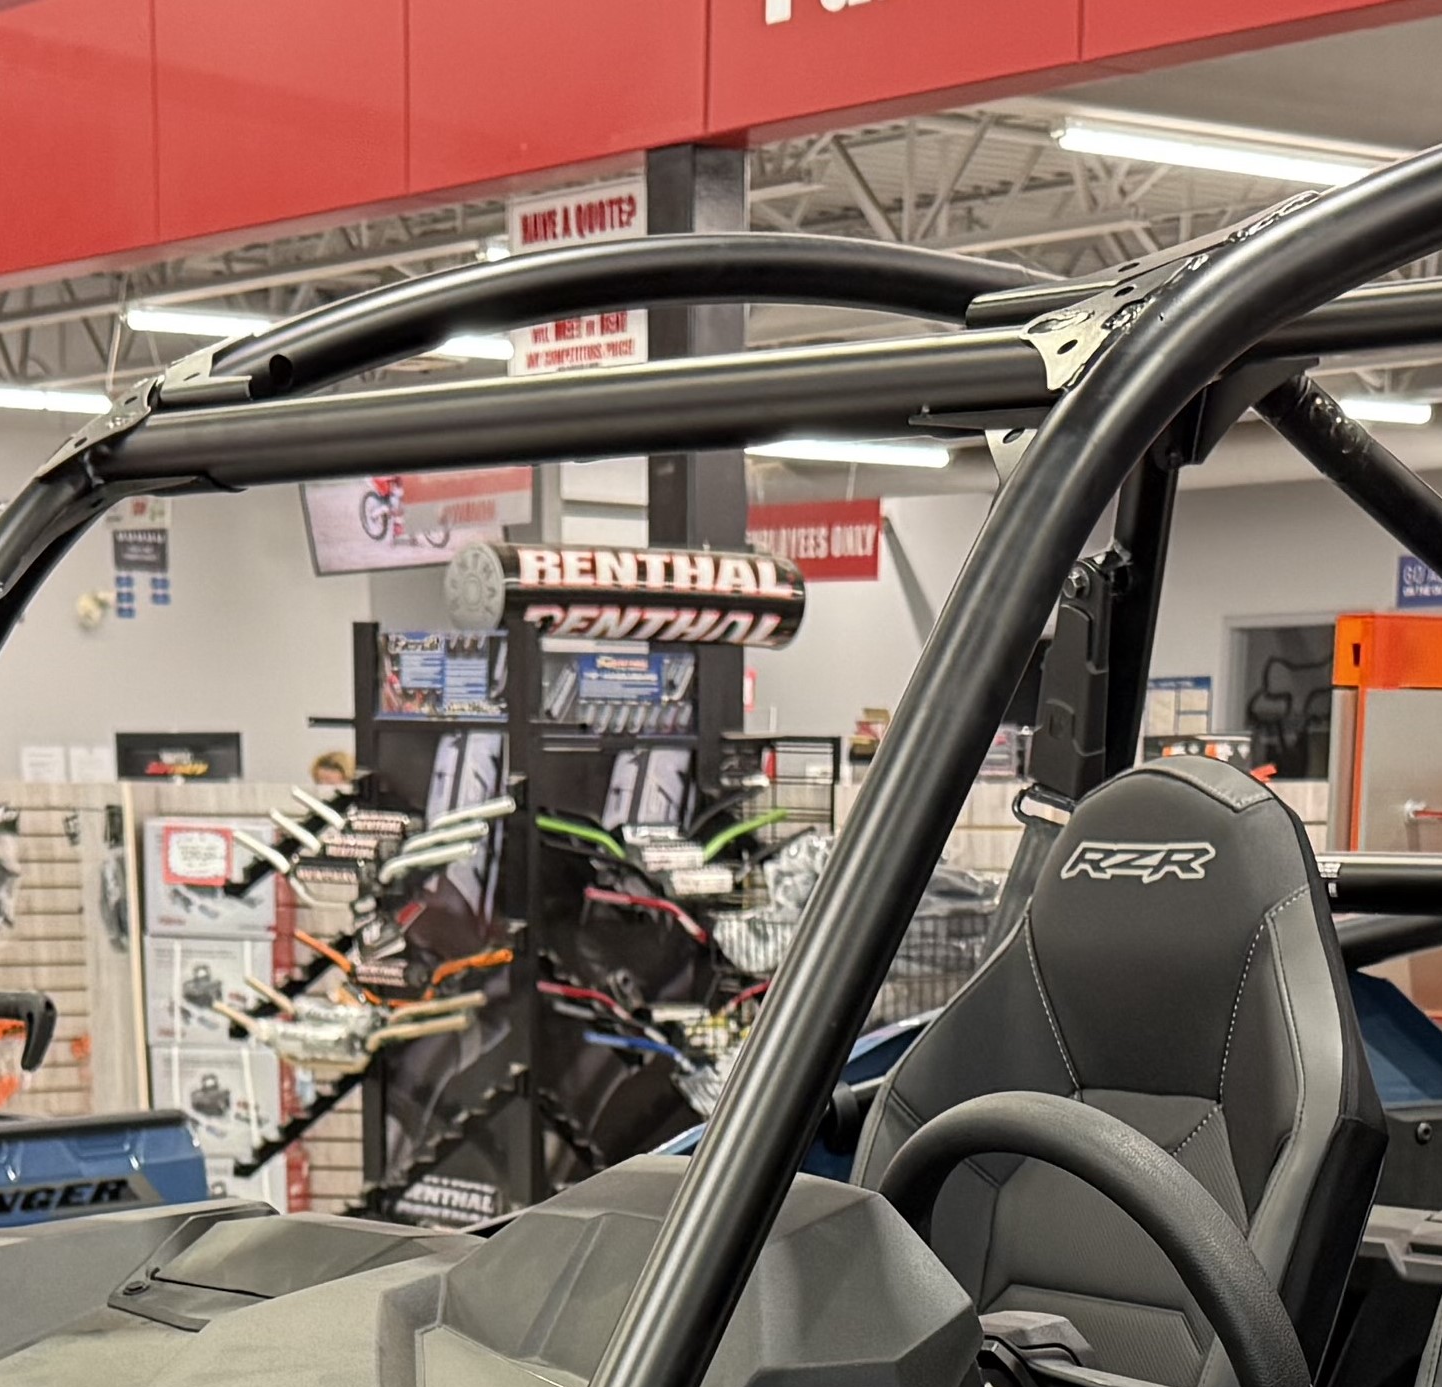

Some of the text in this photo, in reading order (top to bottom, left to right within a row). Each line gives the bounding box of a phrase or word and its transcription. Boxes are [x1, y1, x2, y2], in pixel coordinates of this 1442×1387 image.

[521, 194, 637, 246] HAVE A QUOTE?
[831, 524, 877, 558] ONLY
[518, 549, 792, 596] RENTHAL
[1061, 841, 1216, 884] RZR
